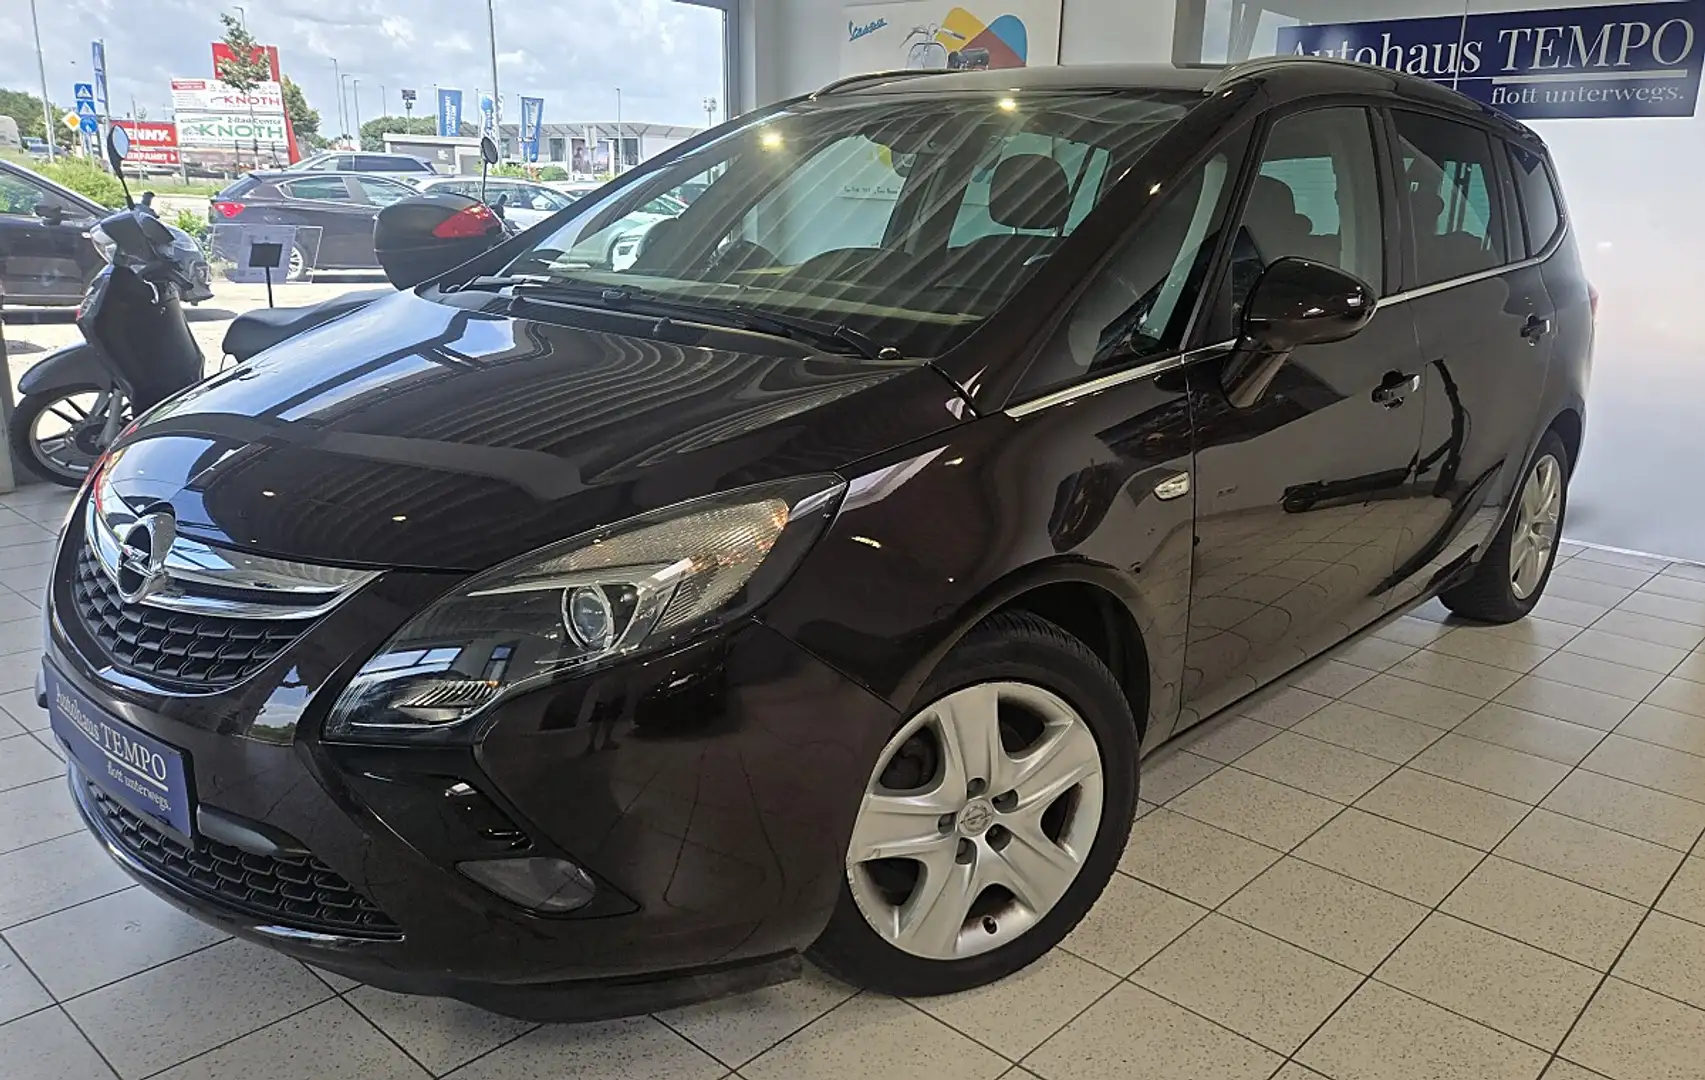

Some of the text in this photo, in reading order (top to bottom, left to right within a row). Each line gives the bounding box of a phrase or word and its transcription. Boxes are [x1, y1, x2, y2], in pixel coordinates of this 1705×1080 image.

[849, 17, 888, 42] Vespa
[1292, 18, 1695, 75] tohaus TEMPO
[223, 95, 280, 106] KNOTH
[1490, 85, 1685, 105] flott unterwegs.
[199, 123, 284, 138] KNOTH
[99, 721, 167, 781] TEMPO
